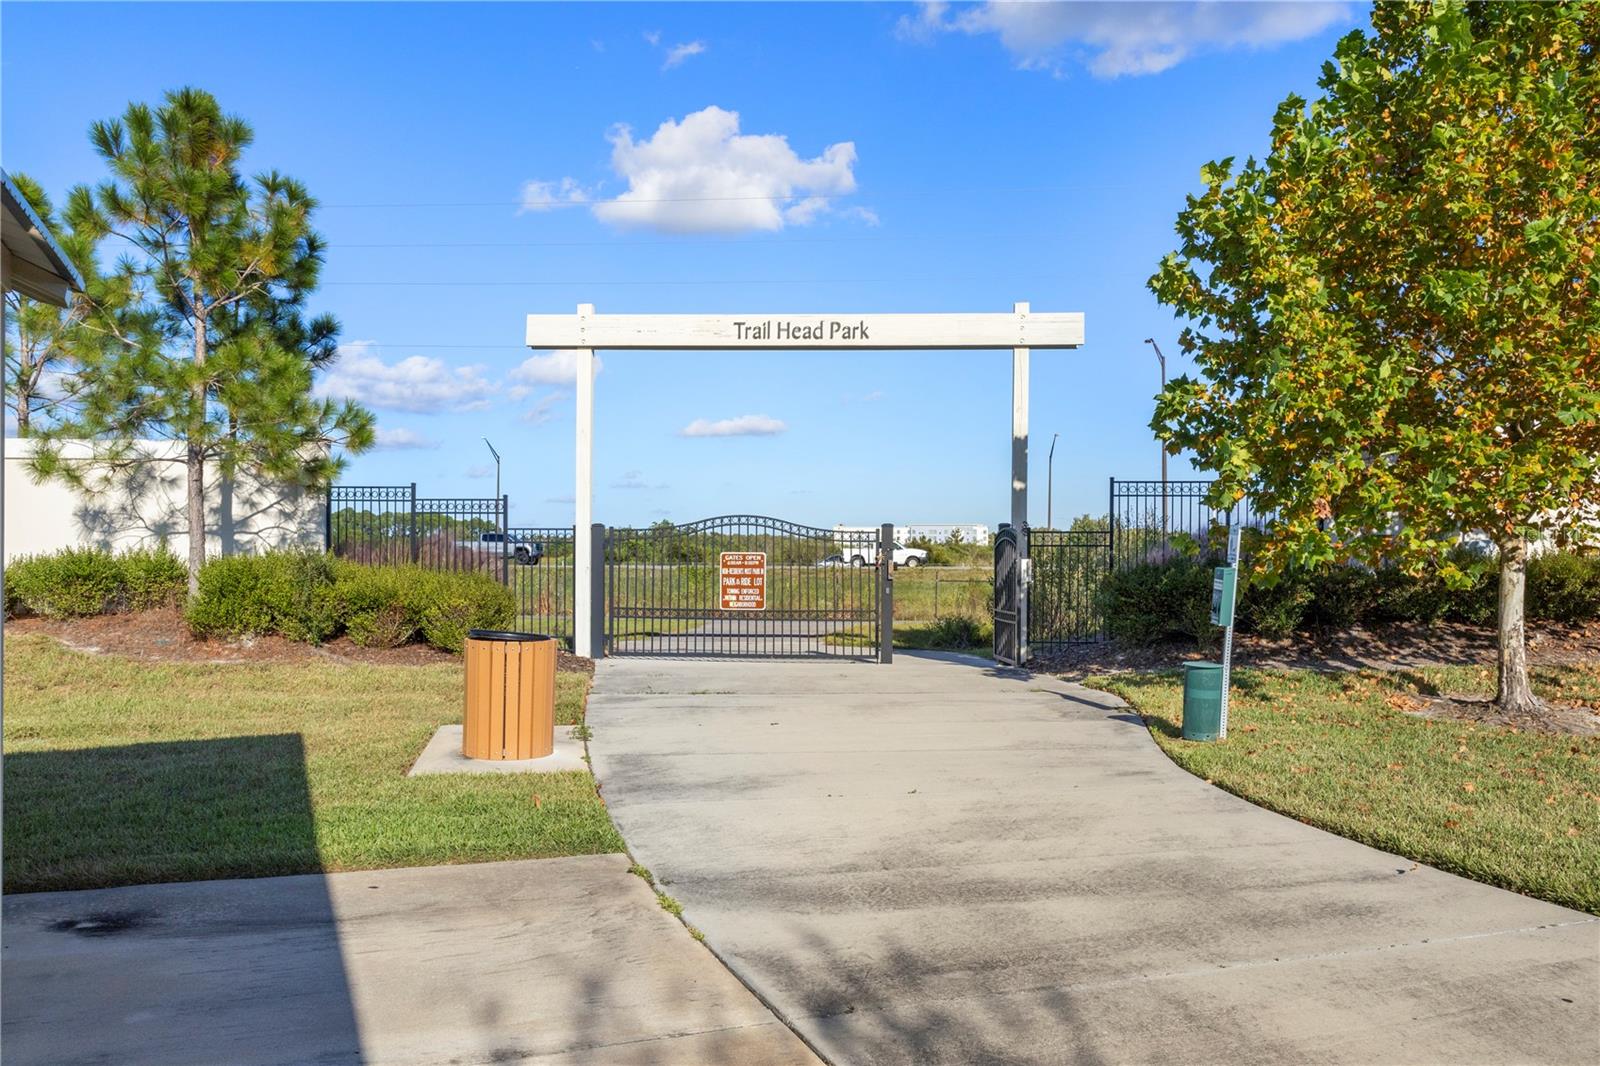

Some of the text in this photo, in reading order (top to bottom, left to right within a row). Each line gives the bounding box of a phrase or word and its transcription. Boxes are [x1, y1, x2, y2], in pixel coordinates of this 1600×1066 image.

[733, 320, 870, 340] Trail Head Park
[723, 577, 736, 586] PARK
[740, 577, 751, 586] RIDE
[753, 577, 763, 586] LOT
